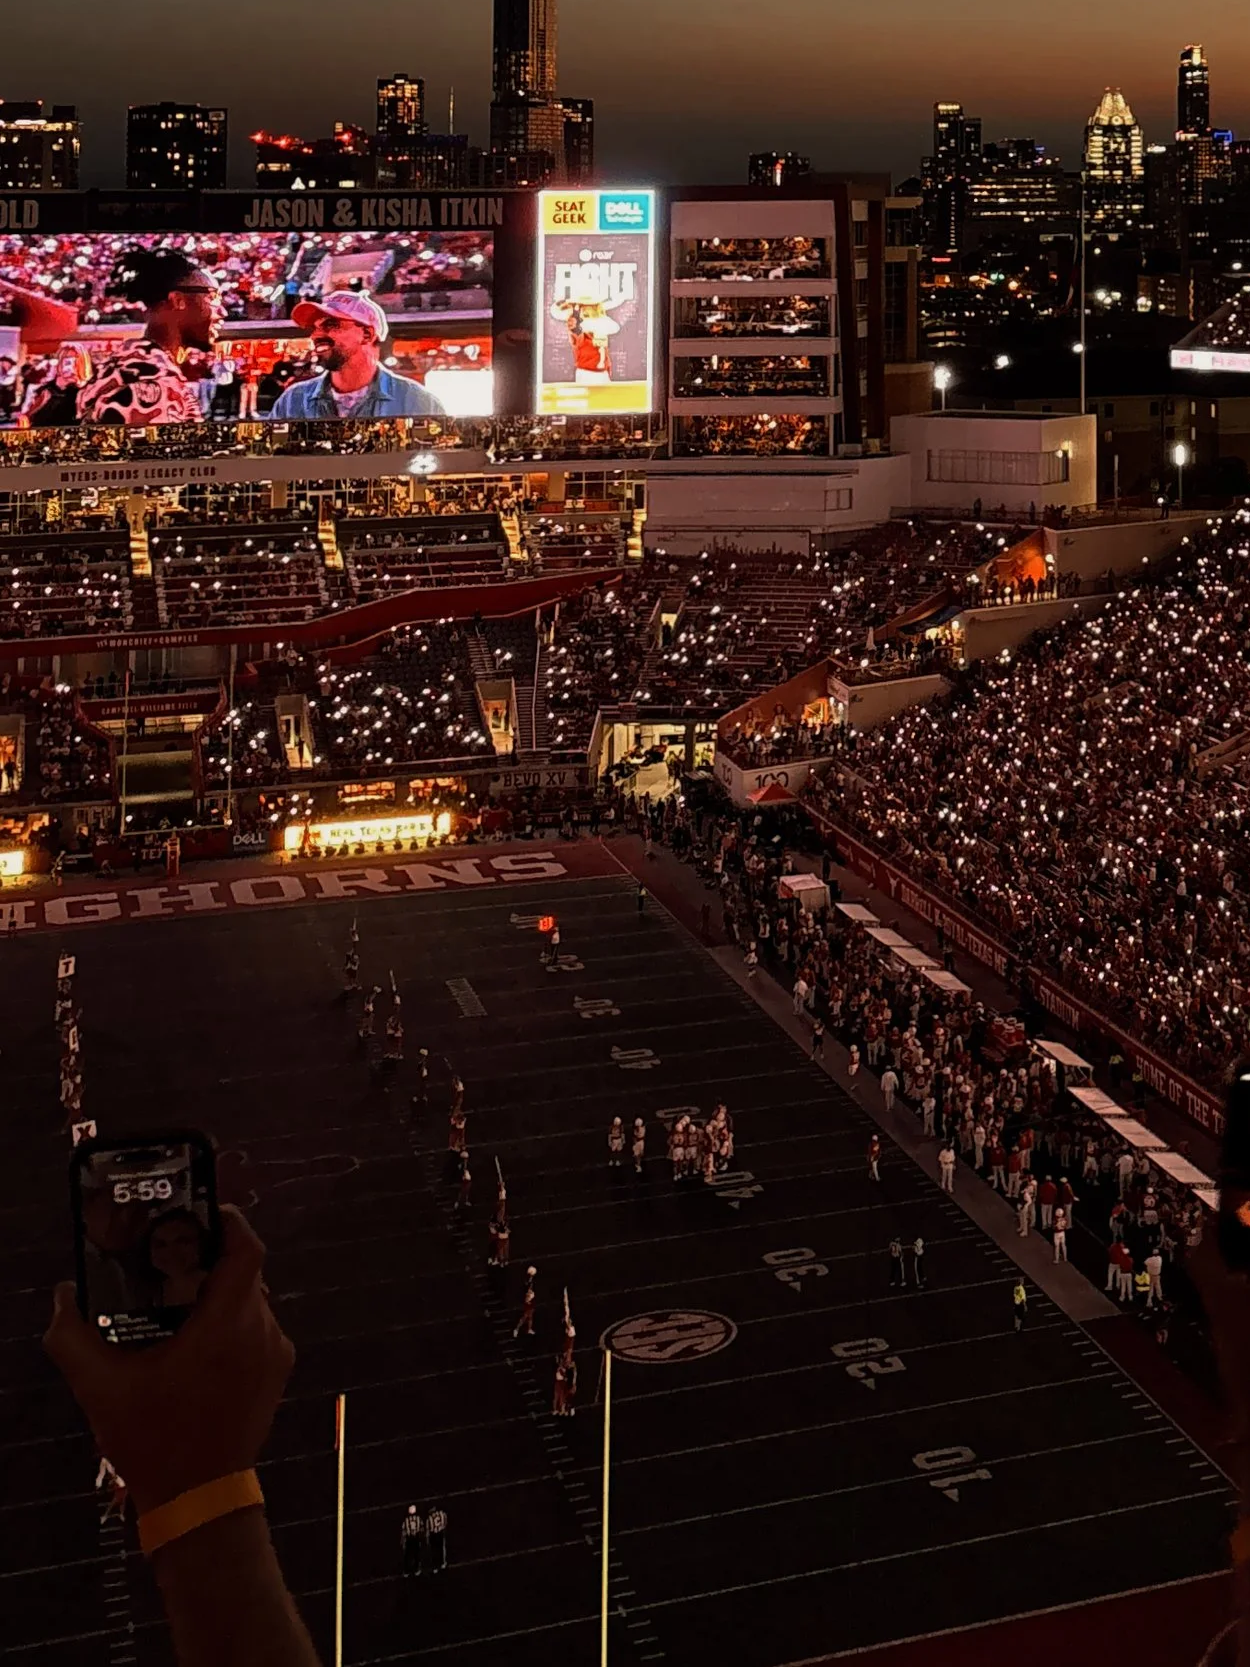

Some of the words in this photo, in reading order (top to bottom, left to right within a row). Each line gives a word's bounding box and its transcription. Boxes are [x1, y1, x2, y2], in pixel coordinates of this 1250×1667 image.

[244, 199, 324, 228] JASON
[333, 199, 356, 227] &
[362, 199, 431, 227] KISHA
[441, 197, 503, 226] ITKIN
[553, 213, 586, 224] GEEK
[555, 201, 585, 212] SEAT
[554, 262, 637, 303] FIGHT
[144, 467, 184, 479] LEGACY
[503, 772, 541, 787] BEVO
[546, 772, 567, 785] XV
[232, 833, 266, 846] DELL
[1136, 1054, 1167, 1097] HOME
[1168, 1079, 1183, 1107] OF
[1186, 1091, 1209, 1130] THE
[113, 1178, 173, 1204] 5:59
[761, 1247, 830, 1282] 30
[829, 1337, 907, 1379] 20
[912, 1445, 993, 1489] 10
